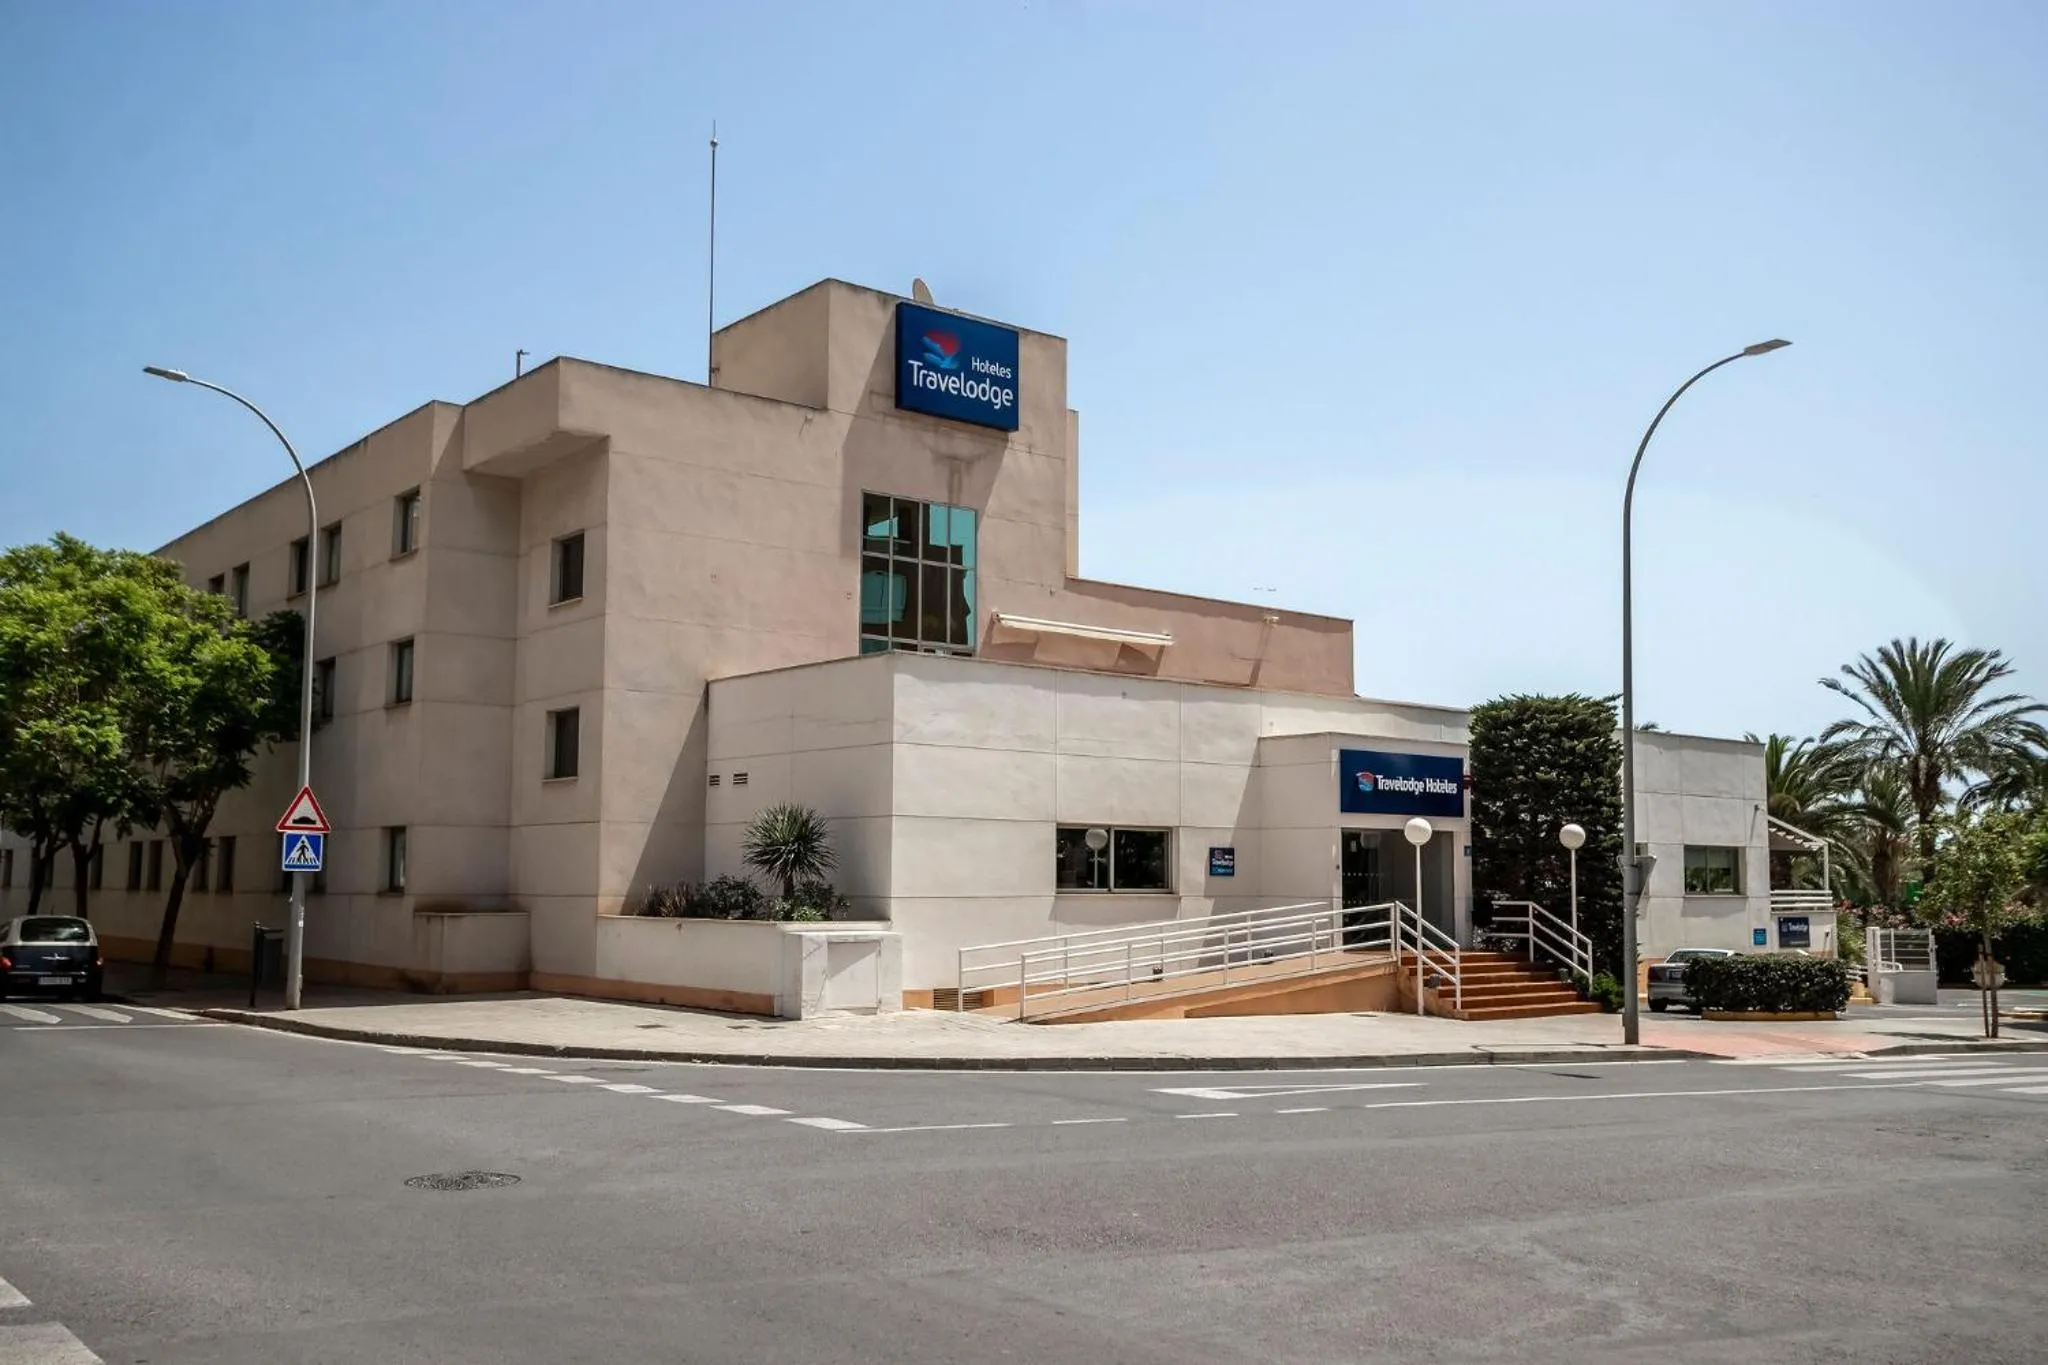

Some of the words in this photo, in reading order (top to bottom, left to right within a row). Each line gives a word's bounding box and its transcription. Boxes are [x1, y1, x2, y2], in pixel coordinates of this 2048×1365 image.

[971, 356, 1012, 379] Hoteles
[908, 360, 1013, 409] Travelodge
[1376, 775, 1424, 795] Travelodge
[1426, 778, 1457, 794] Hoteles
